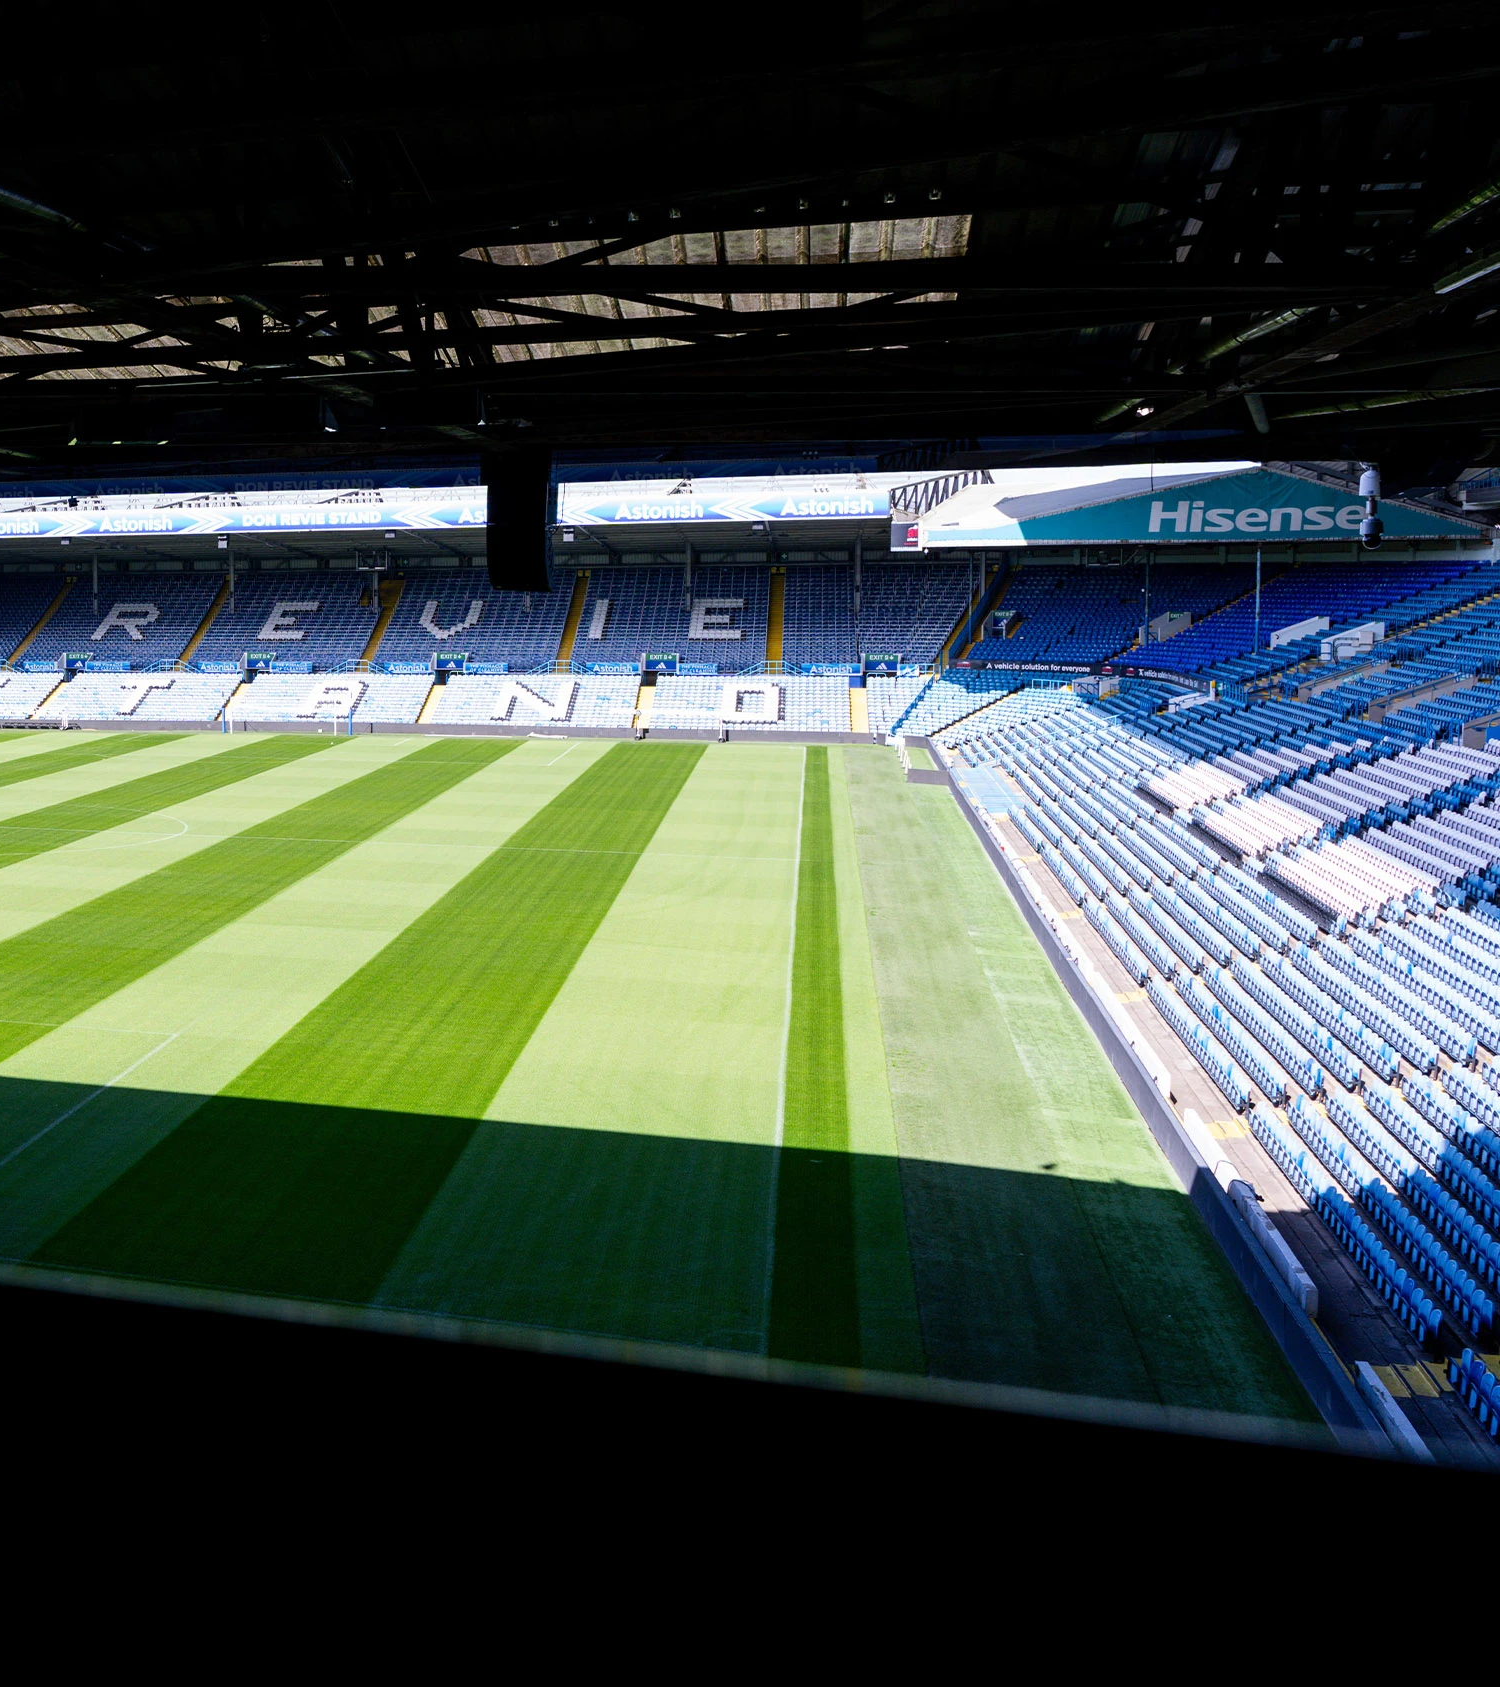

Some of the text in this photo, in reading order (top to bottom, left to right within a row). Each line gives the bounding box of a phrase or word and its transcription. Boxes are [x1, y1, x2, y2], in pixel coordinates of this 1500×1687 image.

[615, 501, 704, 521] Astonish
[780, 496, 873, 517] Astonish
[242, 511, 382, 527] DON REVIE STAND
[1148, 500, 1367, 533] Hisense
[99, 514, 173, 532] Astonish
[24, 662, 54, 671] Astonish
[200, 663, 235, 671] Astonish
[388, 663, 425, 672] Astonish
[593, 664, 633, 672] Astonish
[810, 665, 853, 673] Astonish
